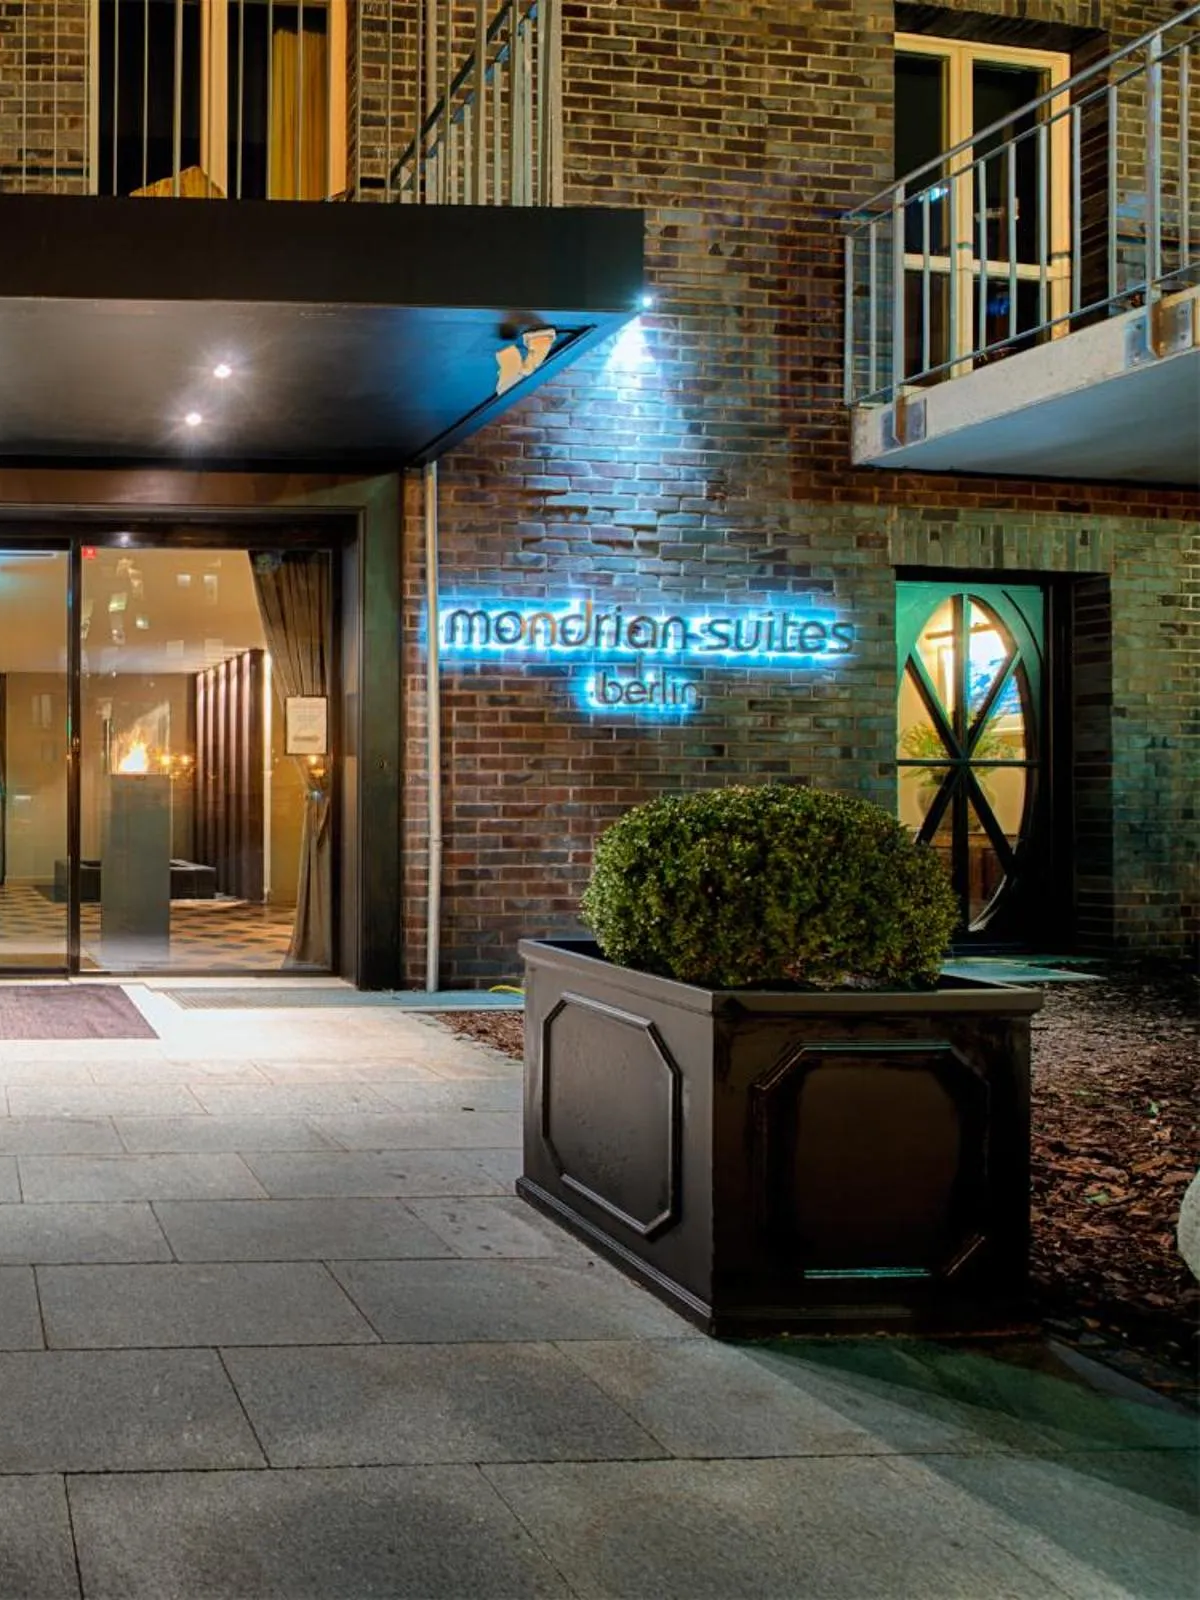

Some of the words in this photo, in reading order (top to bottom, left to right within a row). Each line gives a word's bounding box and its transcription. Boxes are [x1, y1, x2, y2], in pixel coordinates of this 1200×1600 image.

[444, 600, 687, 650] mondrian
[701, 610, 855, 653] suites
[597, 670, 698, 704] berlin
